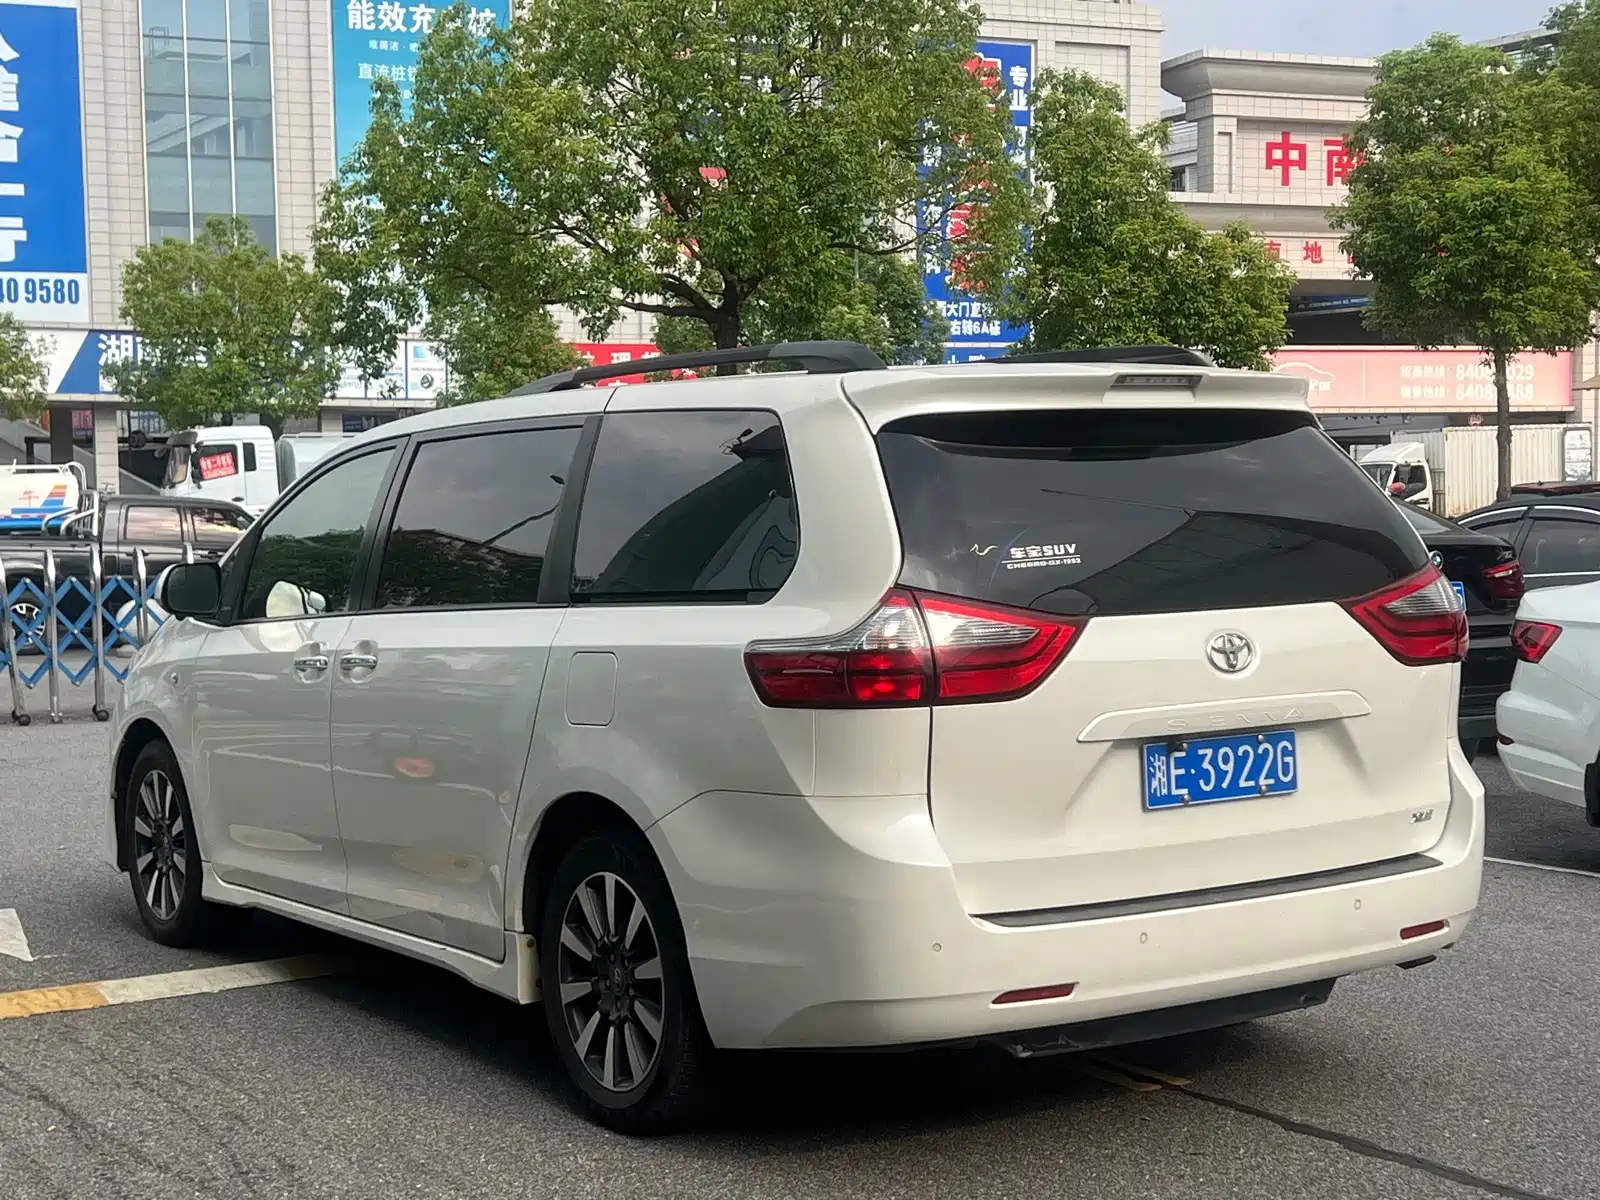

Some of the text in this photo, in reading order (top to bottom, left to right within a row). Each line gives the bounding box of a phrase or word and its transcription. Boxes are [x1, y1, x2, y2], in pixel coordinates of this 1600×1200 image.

[347, 1, 496, 37] 能效充桩
[24, 278, 80, 304] 9580
